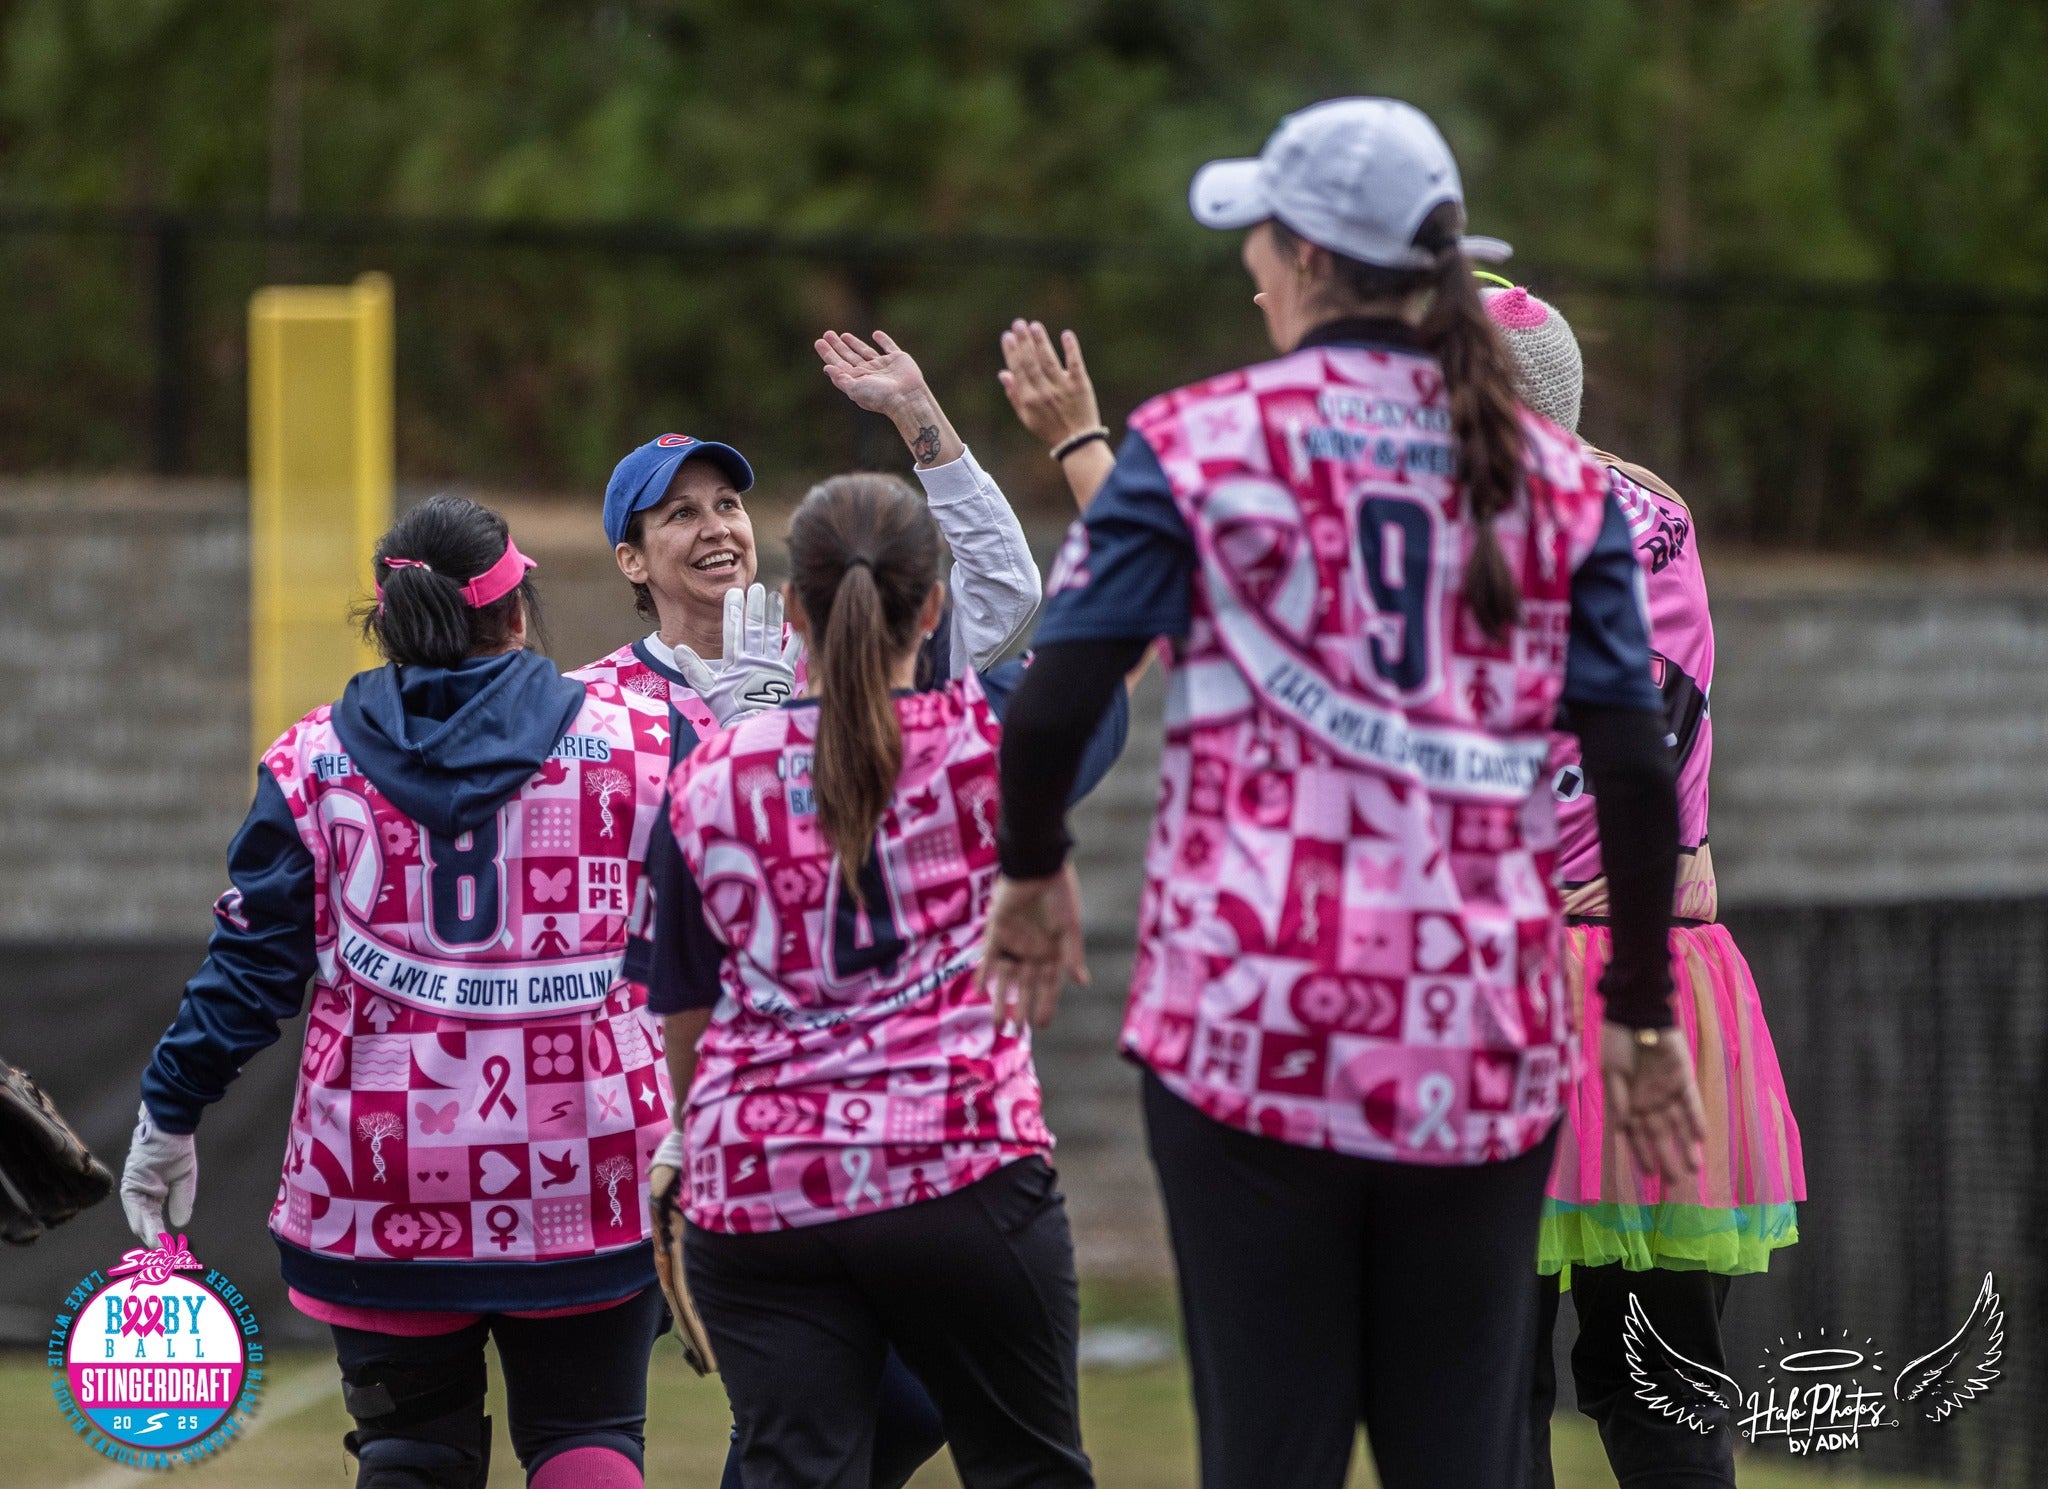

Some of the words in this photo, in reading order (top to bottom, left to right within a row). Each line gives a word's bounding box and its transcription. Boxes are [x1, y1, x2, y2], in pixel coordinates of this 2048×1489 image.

[657, 433, 695, 448] C
[1354, 488, 1442, 702] 9
[313, 755, 349, 779] THE
[421, 806, 507, 954] 8
[588, 862, 621, 885] HO
[589, 888, 623, 910] PE
[342, 936, 389, 981] LAKE
[389, 963, 448, 1004] WYLIE,
[456, 978, 518, 1006] SOUTH
